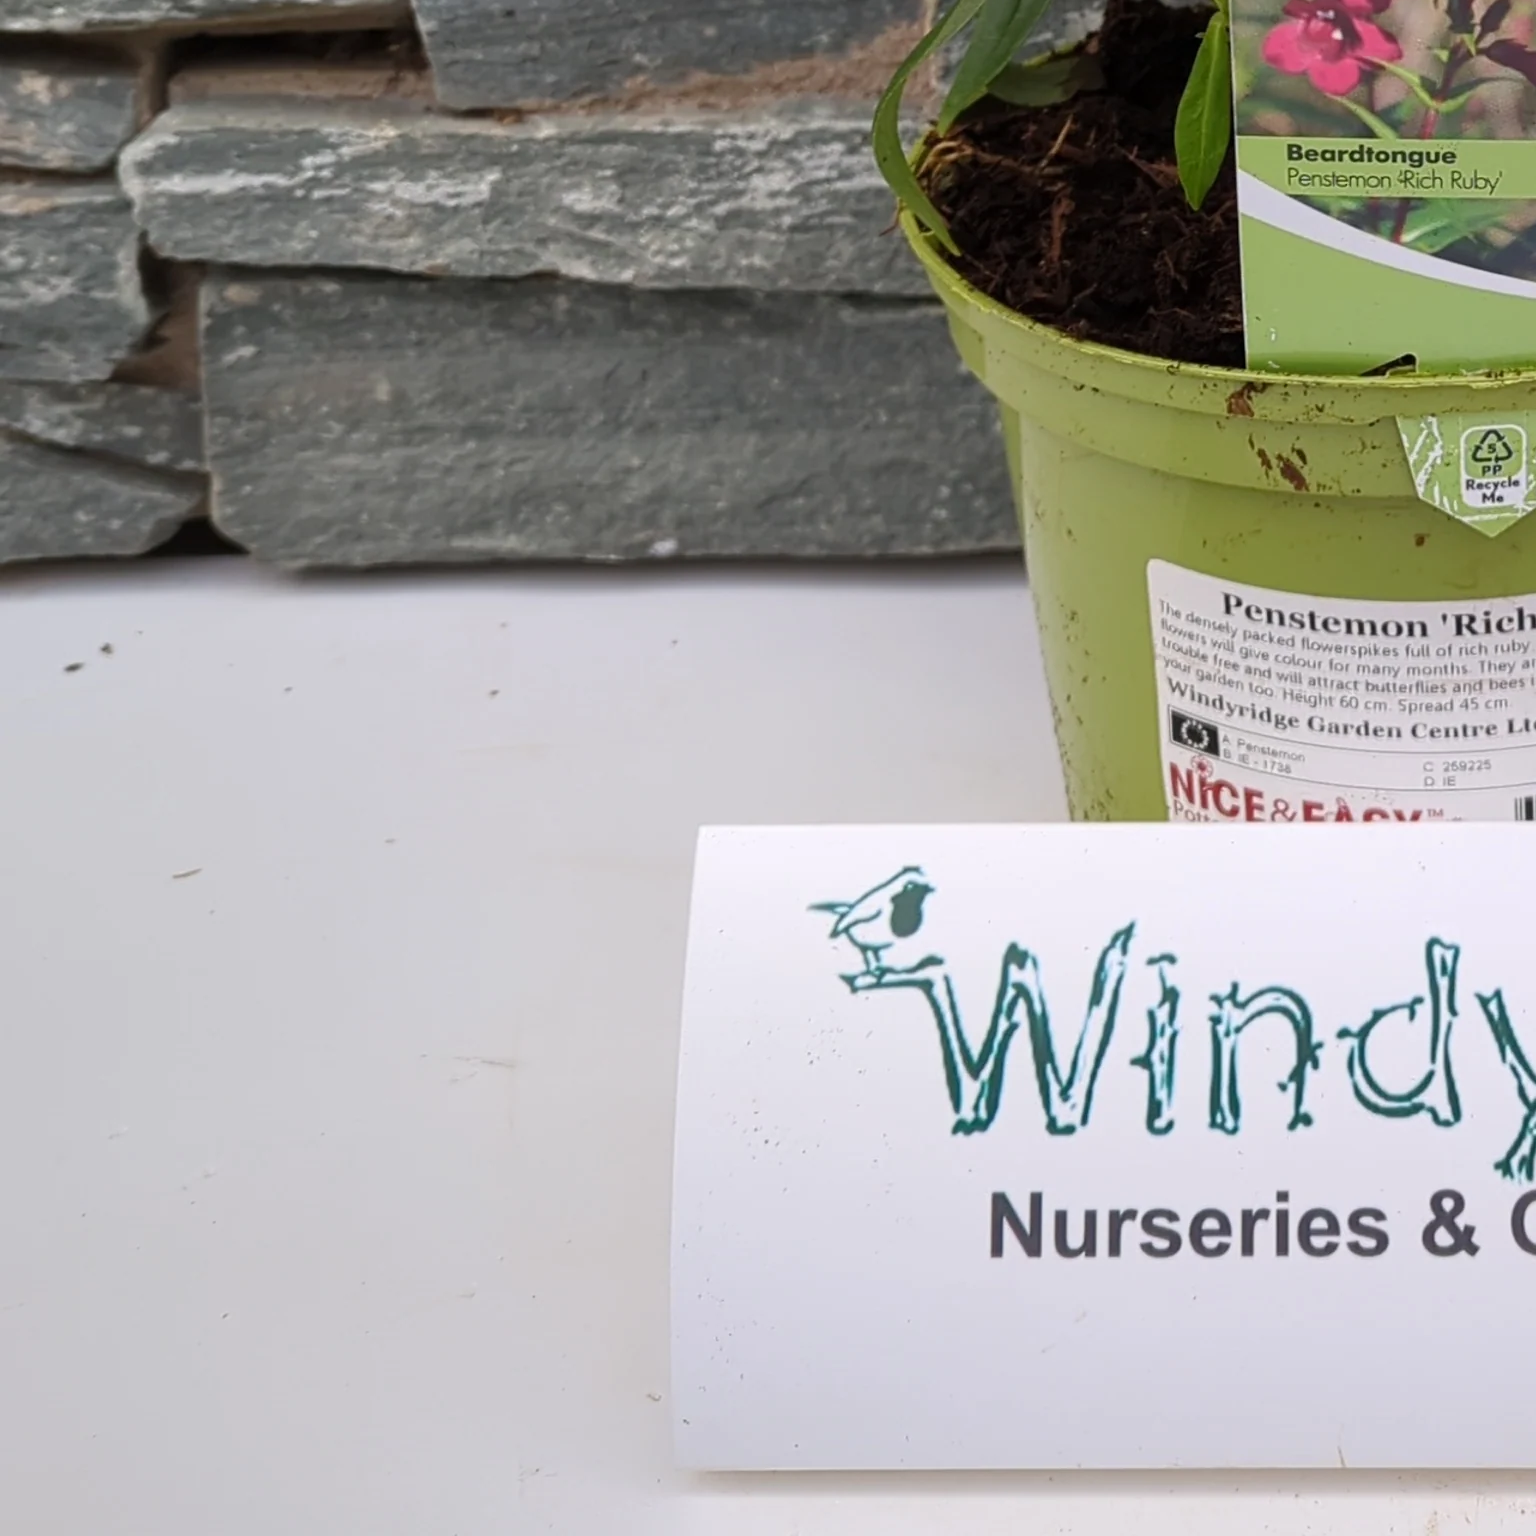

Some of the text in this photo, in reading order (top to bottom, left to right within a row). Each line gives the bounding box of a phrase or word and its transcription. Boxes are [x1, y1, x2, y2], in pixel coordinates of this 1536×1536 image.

[1286, 143, 1457, 168] Beardtongue
[1287, 167, 1392, 189] Penstemon
[1481, 465, 1503, 477] PP
[1465, 478, 1521, 493] Recycle
[1481, 493, 1505, 504] Me
[1220, 591, 1429, 638] Penstemon
[1159, 598, 1182, 619] The
[1186, 612, 1238, 639] densely
[1243, 629, 1296, 647] packed
[1301, 637, 1400, 659] flowerspikes
[1405, 643, 1431, 658] full
[1435, 642, 1453, 657] of
[1459, 642, 1489, 656] rich
[1160, 618, 1207, 645] flowers
[1211, 638, 1235, 653] will
[1239, 645, 1270, 661] give
[1274, 652, 1323, 670] colour
[1329, 658, 1351, 673] for
[1356, 663, 1401, 678] many
[1478, 660, 1517, 675] They
[1162, 636, 1209, 663] trouble
[1213, 654, 1240, 672] free
[1245, 664, 1272, 679] and
[1276, 670, 1303, 685] will
[1308, 676, 1359, 691] attract
[1365, 679, 1448, 695] butterflies
[1452, 679, 1484, 696] and
[1489, 677, 1526, 691] bees
[1163, 655, 1192, 675] your
[1196, 667, 1245, 691] garden
[1282, 689, 1335, 709] Height
[1339, 695, 1359, 710] 60
[1398, 697, 1454, 715] Spread
[1459, 697, 1480, 711] 45
[1167, 677, 1301, 730] Windyridge
[1307, 714, 1402, 739] Garden
[1411, 721, 1499, 739] Centre
[1237, 737, 1306, 763] Penstemon
[1238, 753, 1250, 765] IE
[1443, 776, 1457, 787] IE
[989, 1189, 1391, 1260] Nurseries
[1420, 1188, 1481, 1259] &
